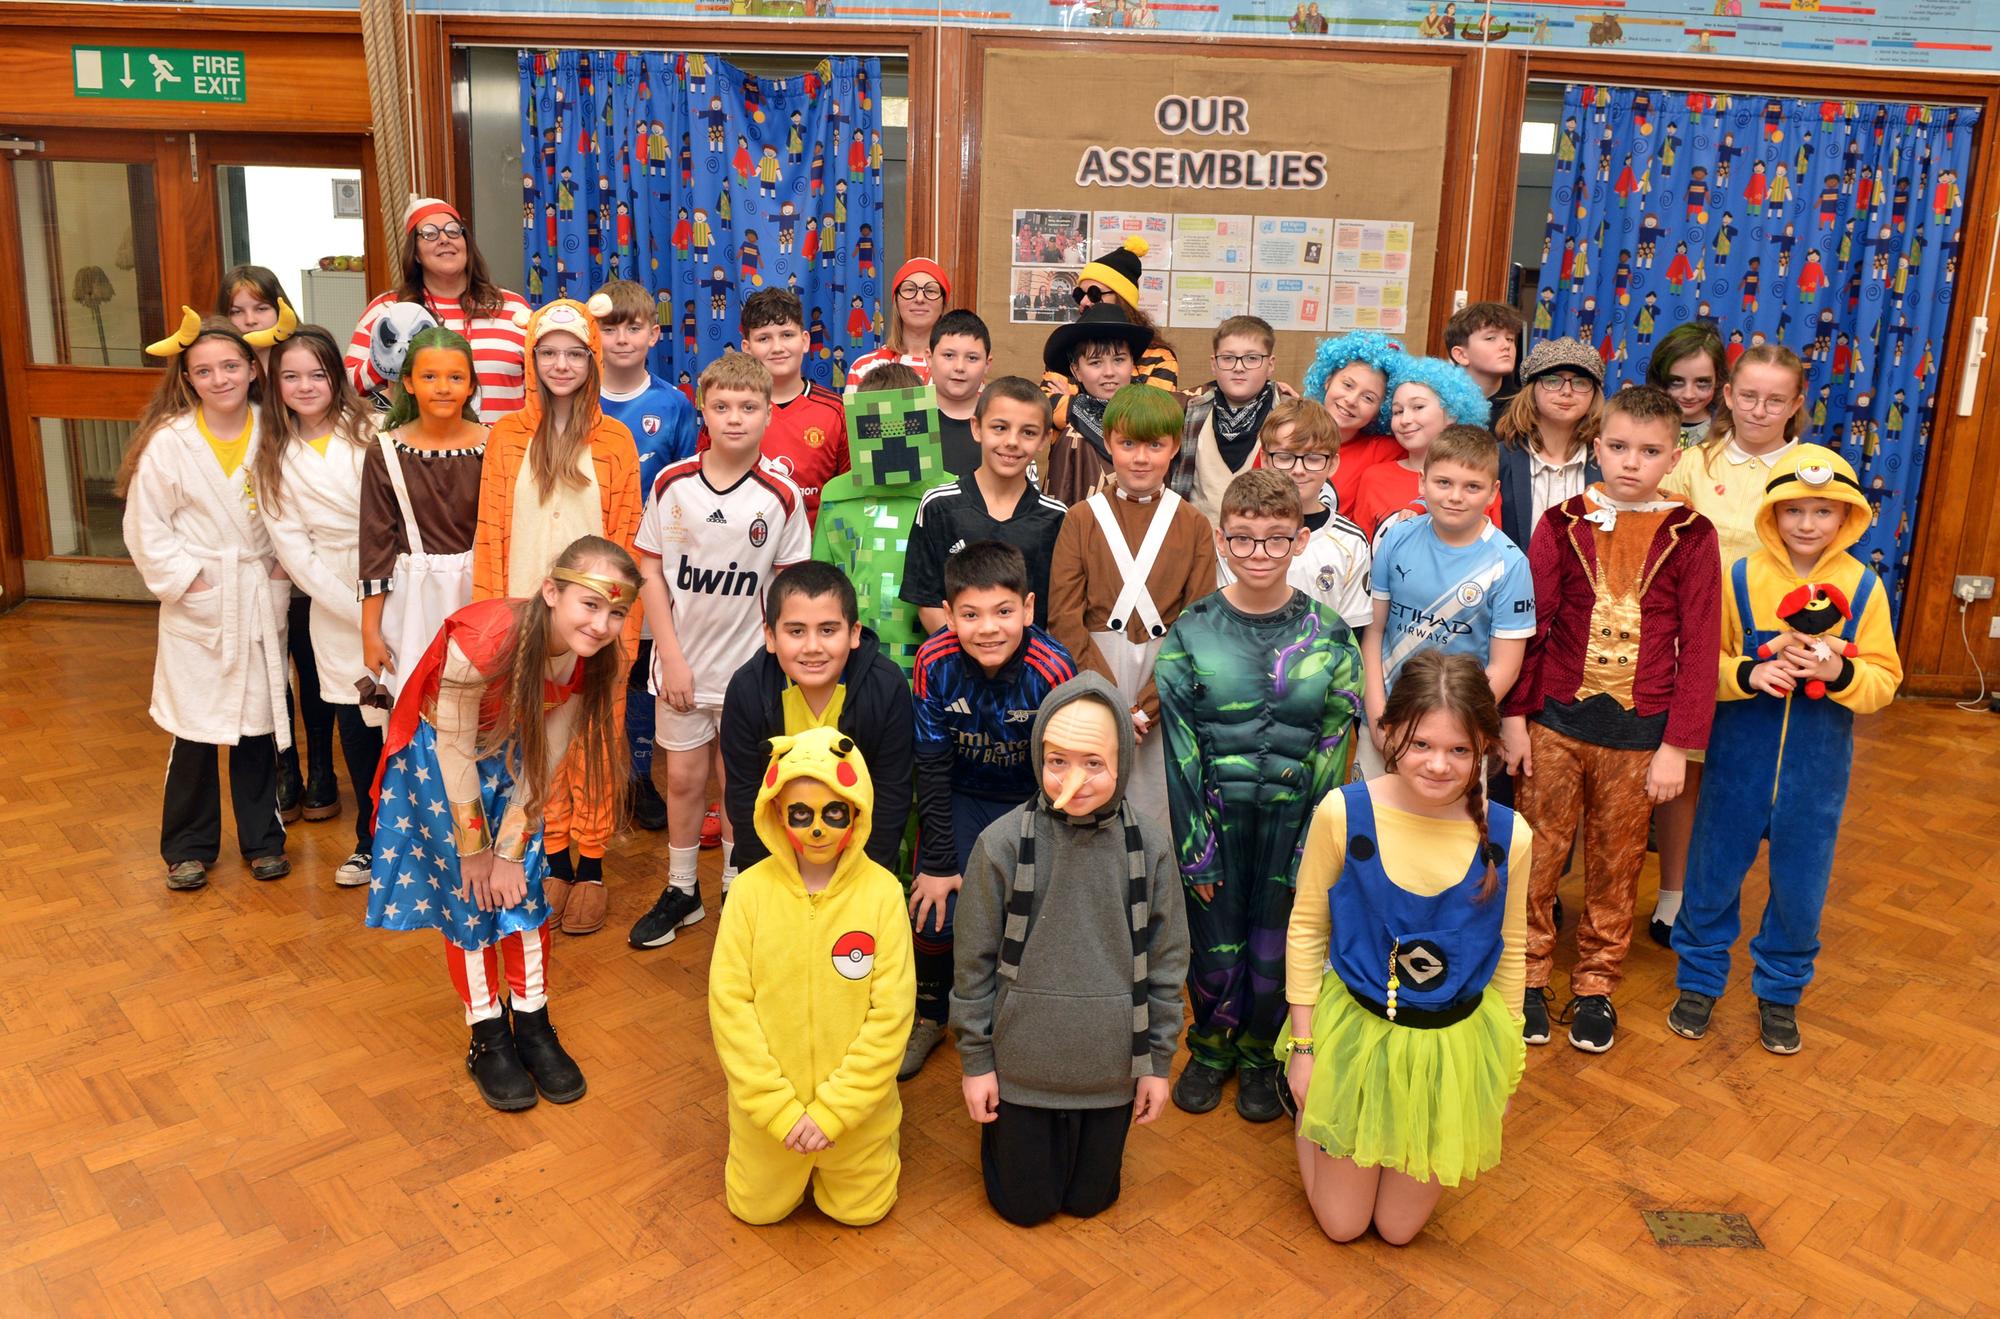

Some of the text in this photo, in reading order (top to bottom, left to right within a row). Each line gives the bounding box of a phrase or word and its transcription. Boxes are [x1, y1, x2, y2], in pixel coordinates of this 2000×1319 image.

[193, 55, 240, 75] FIRE
[194, 76, 241, 96] EXIT
[1157, 97, 1247, 133] OUR
[1078, 149, 1325, 187] ASSEMBLIES
[677, 554, 759, 597] bwin
[1391, 600, 1473, 635] ETIHAD
[1396, 622, 1449, 646] AIRWAYS
[959, 746, 980, 760] FLY
